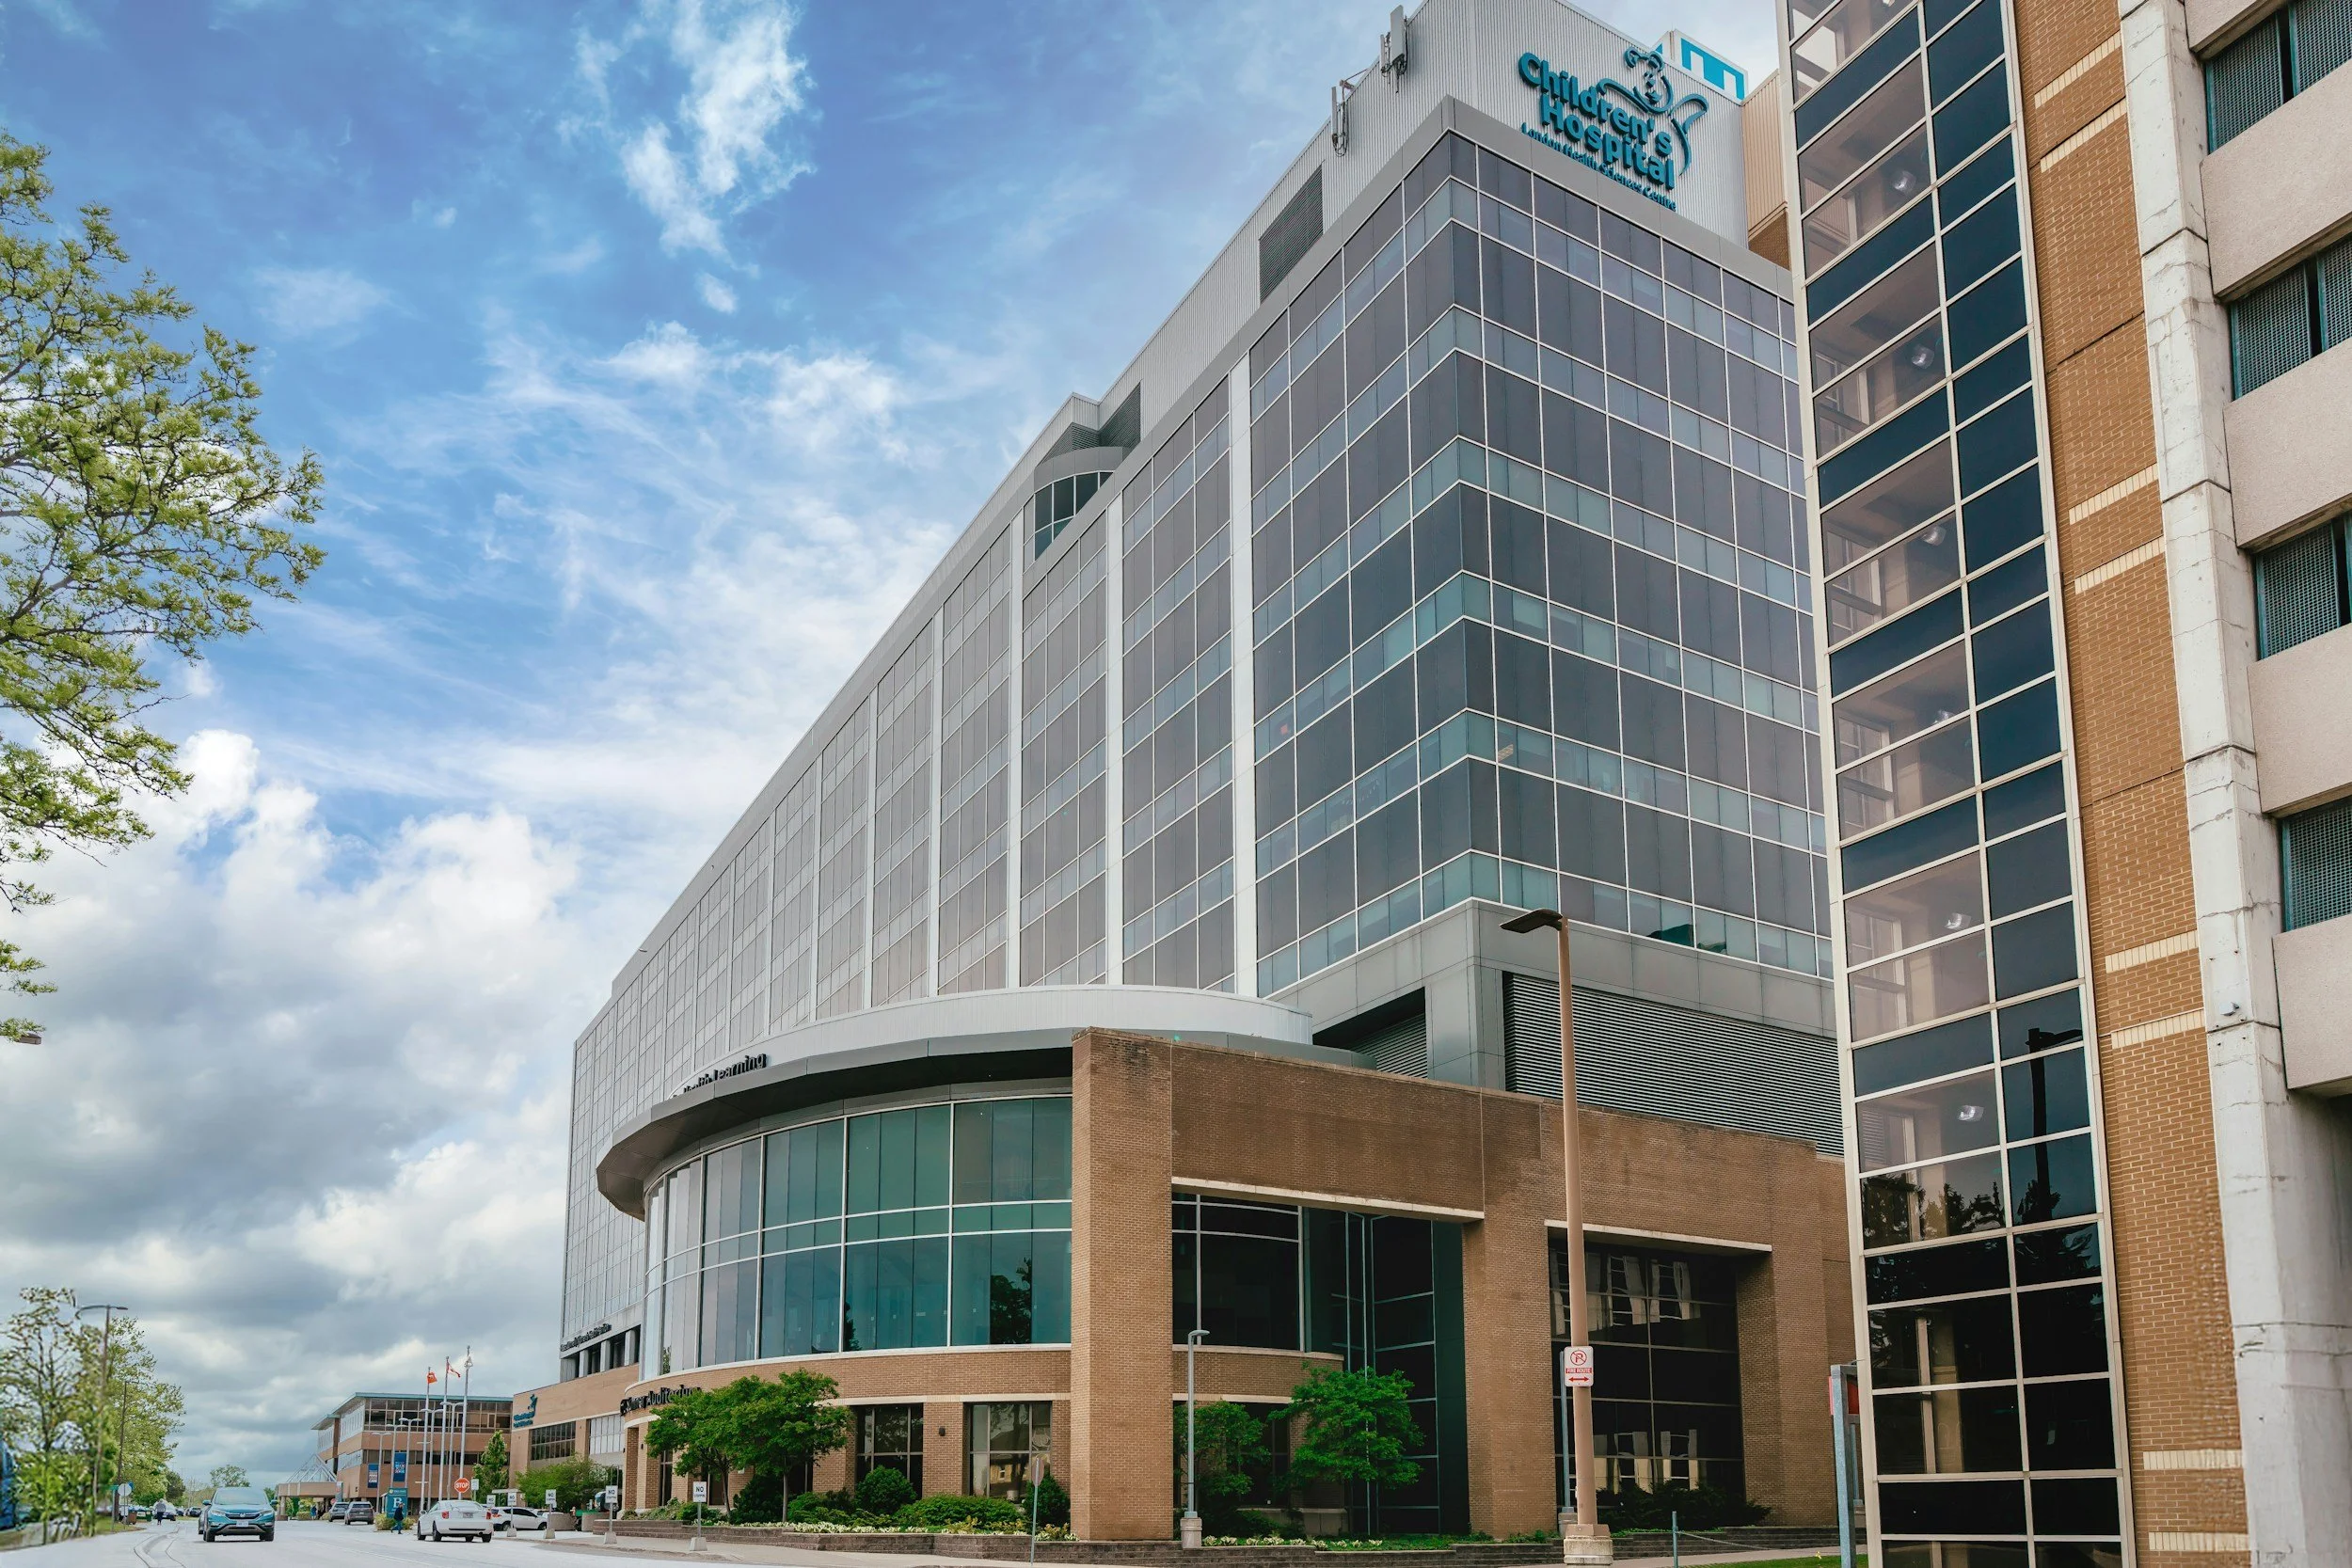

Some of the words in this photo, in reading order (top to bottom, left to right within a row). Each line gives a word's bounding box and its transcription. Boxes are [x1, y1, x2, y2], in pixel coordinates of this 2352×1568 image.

[1518, 52, 1673, 157] Children's
[1541, 94, 1675, 190] Hospital
[1521, 122, 1562, 152] London
[1563, 144, 1598, 171] Health
[1599, 162, 1643, 193] Sciences
[1642, 186, 1677, 212] Centre
